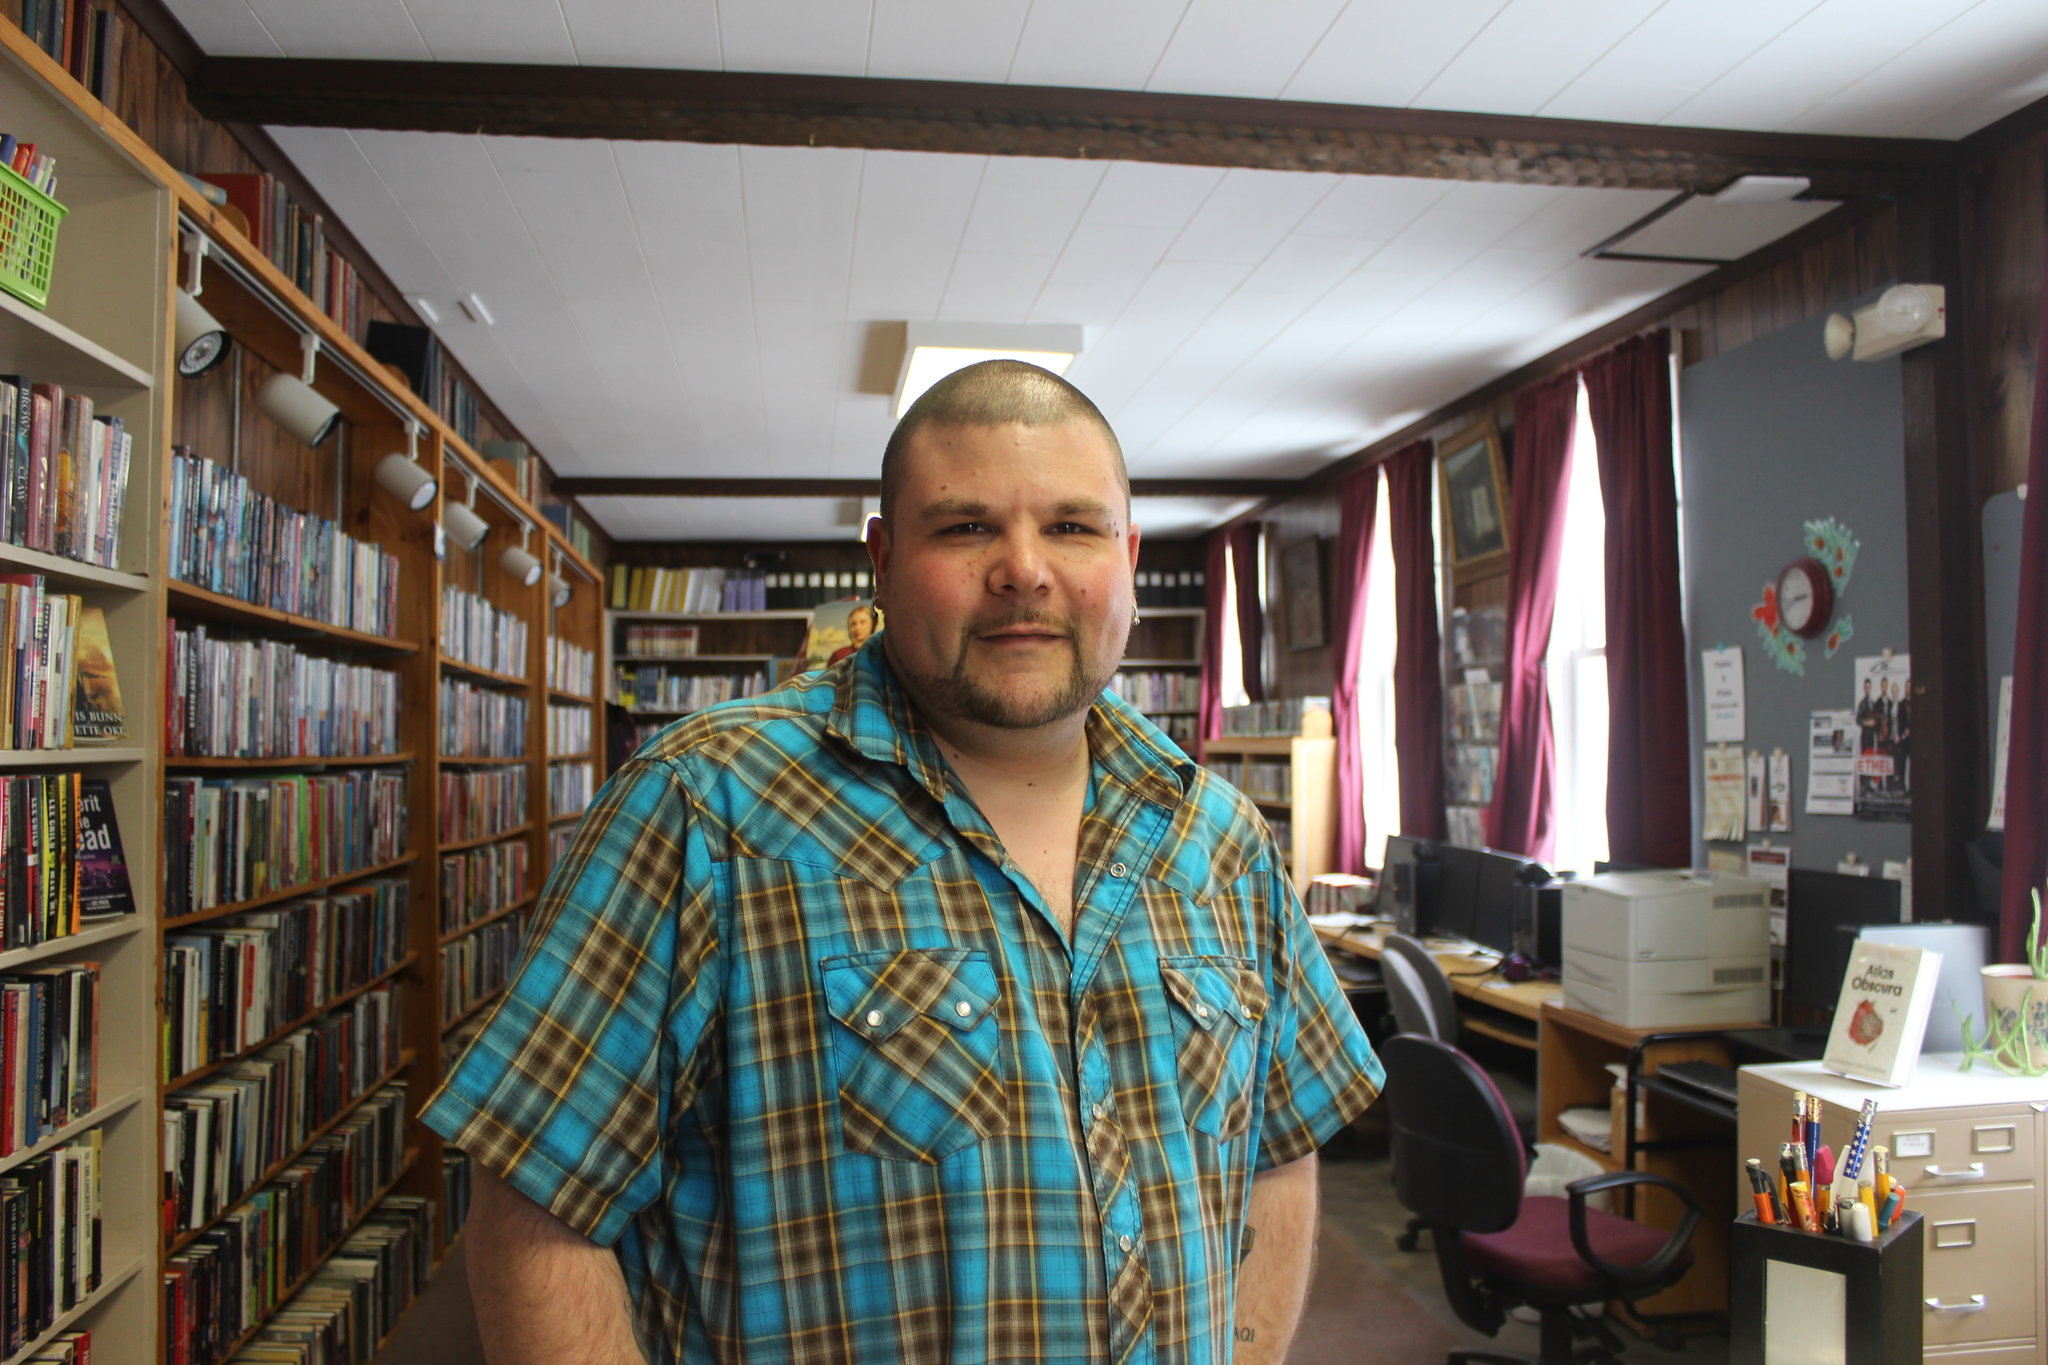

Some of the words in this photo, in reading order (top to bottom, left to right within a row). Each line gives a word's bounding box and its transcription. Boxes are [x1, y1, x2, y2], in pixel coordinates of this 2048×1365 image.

[20, 387, 30, 438] BROWN
[17, 465, 26, 503] CLAW
[89, 711, 121, 722] BUNN
[1857, 758, 1893, 774] ETHEL
[48, 799, 56, 817] LEE
[48, 819, 56, 849] CHILD
[49, 901, 56, 916] ME
[1865, 965, 1894, 979] Atlas
[1852, 977, 1902, 996] Obscura
